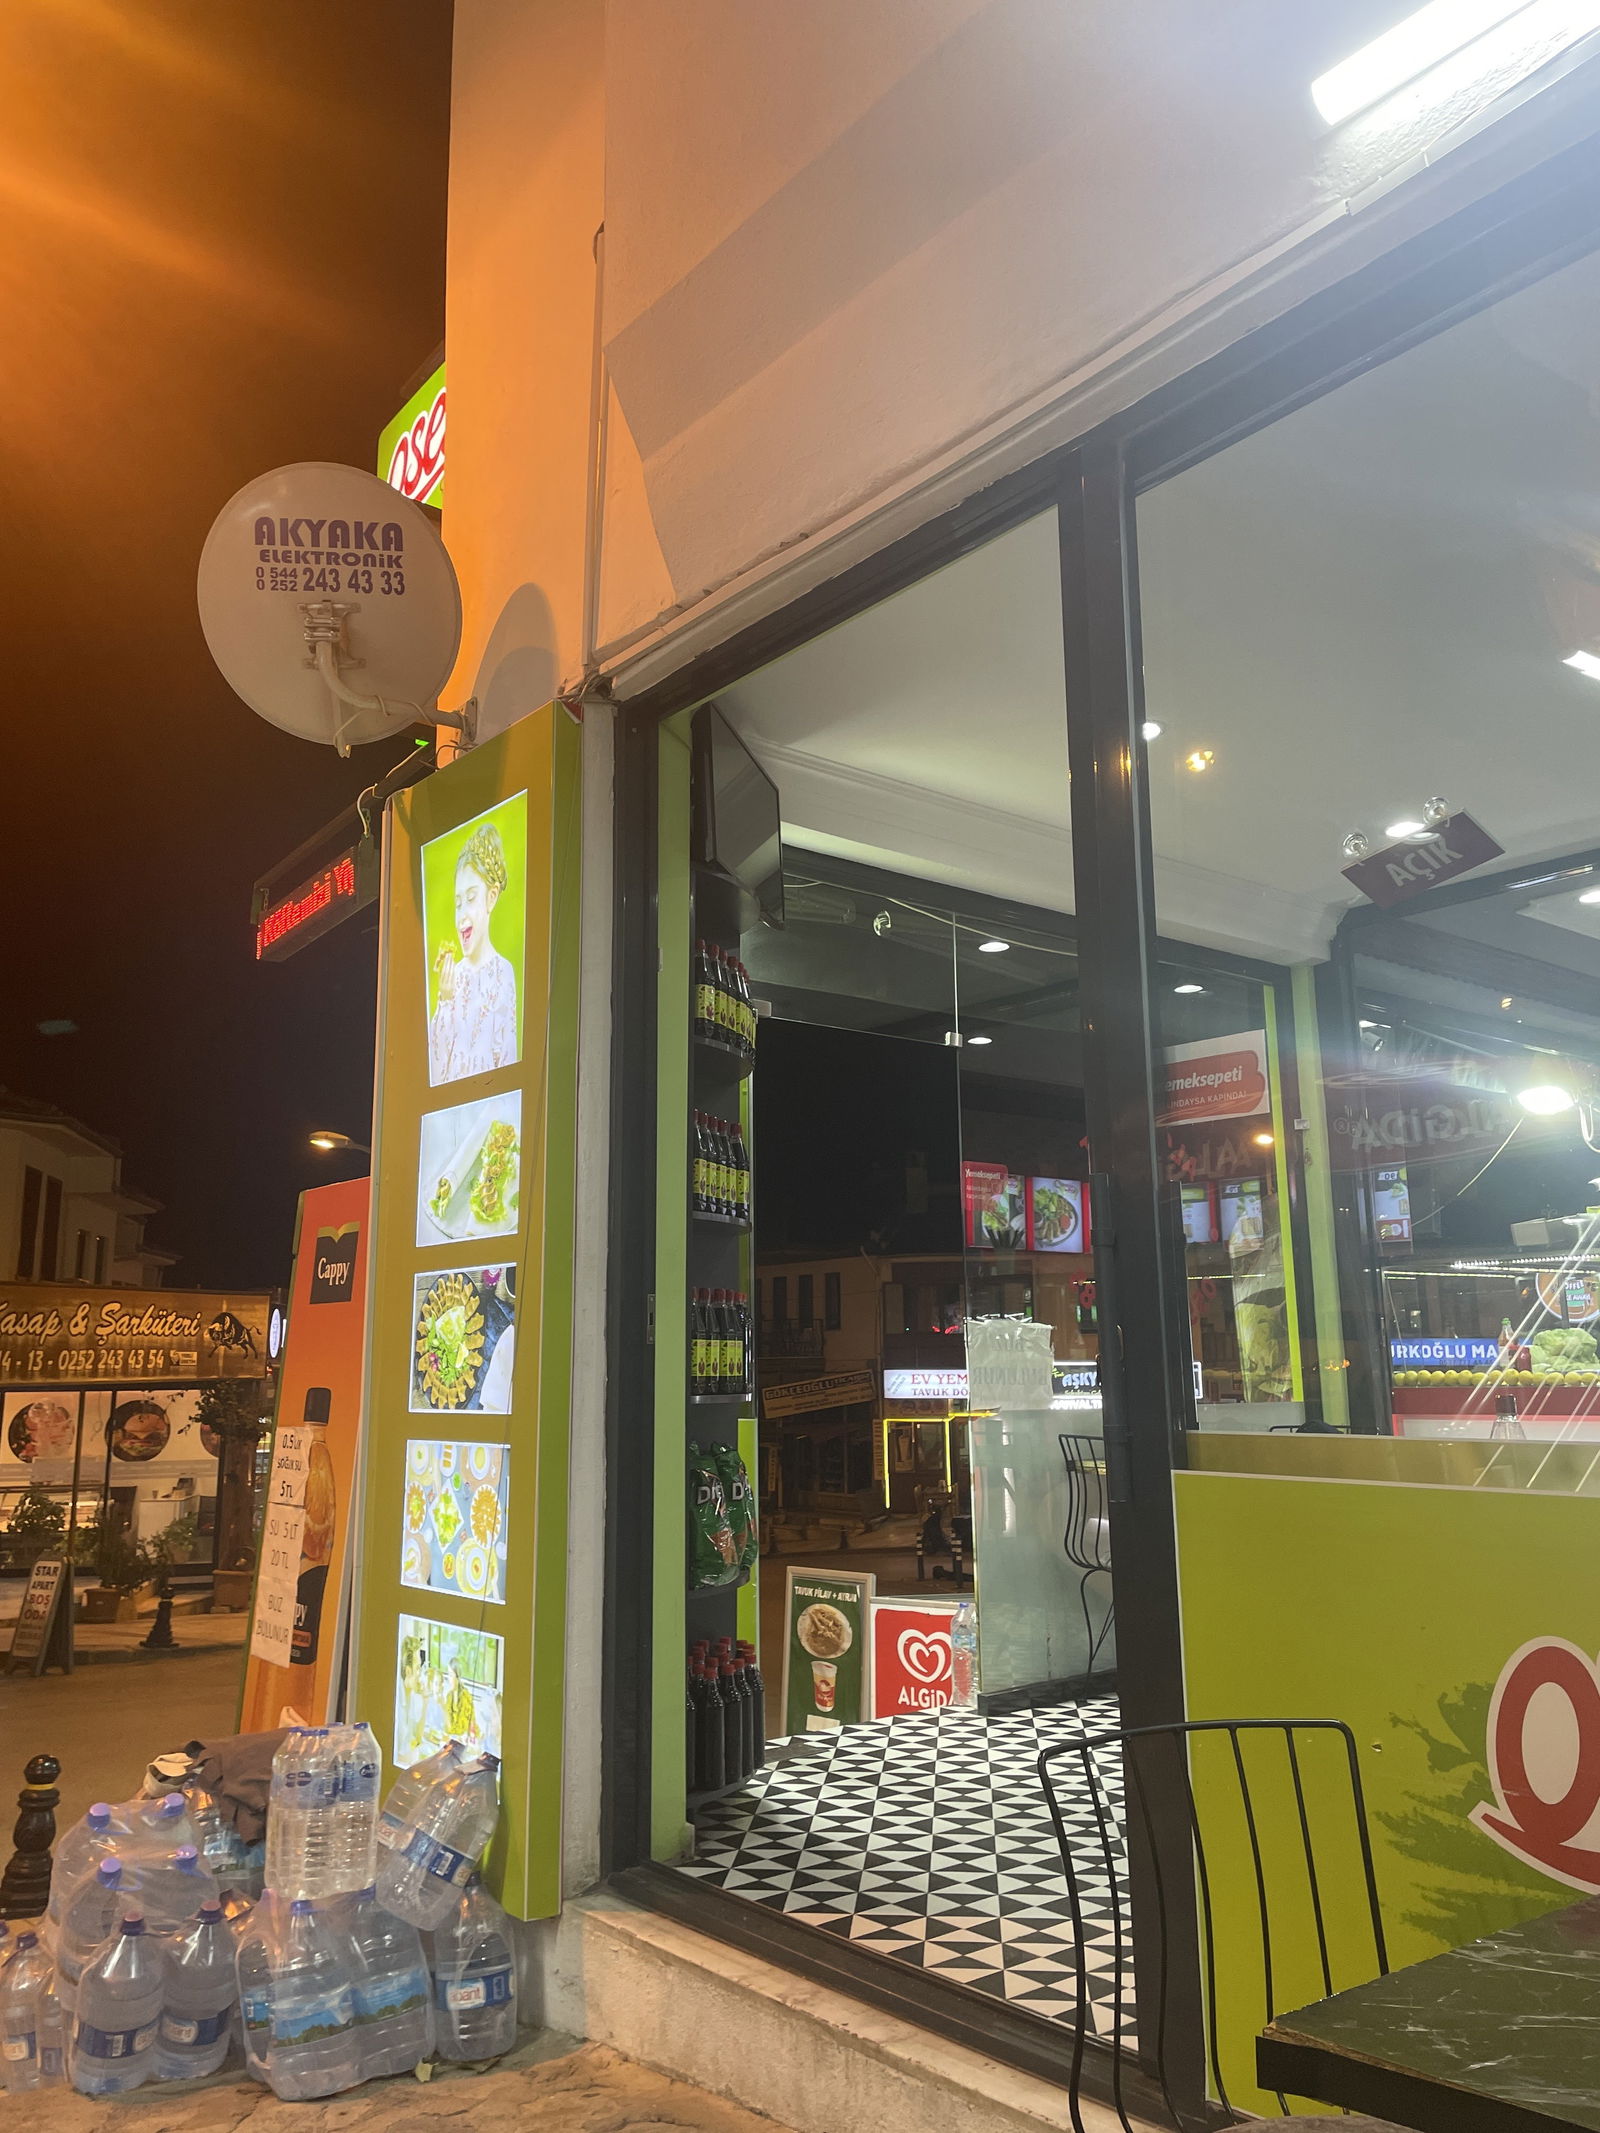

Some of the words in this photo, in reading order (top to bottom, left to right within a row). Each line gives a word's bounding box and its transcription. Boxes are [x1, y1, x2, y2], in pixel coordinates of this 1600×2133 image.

[254, 516, 404, 552] AKYAKA
[255, 567, 264, 578] 0
[270, 567, 298, 579] 544
[256, 579, 265, 591] 0
[270, 580, 298, 592] 252
[302, 567, 341, 593] 243
[347, 569, 374, 594] 43
[380, 571, 405, 596] 33
[1385, 835, 1464, 887] AÇIK
[1166, 1065, 1243, 1092] emeksepeti
[317, 1257, 350, 1286] Cappy
[69, 1302, 90, 1335] &
[95, 1302, 200, 1346] Şarküteri
[0, 1350, 11, 1371] 4
[28, 1350, 44, 1371] 13
[59, 1350, 95, 1370] 0252
[98, 1349, 124, 1369] 243
[128, 1349, 144, 1369] 43
[147, 1349, 164, 1369] 54
[1471, 1344, 1498, 1359] MA
[911, 1373, 931, 1385] EV
[936, 1373, 968, 1385] YEM
[1062, 1371, 1098, 1390] AŞKY
[911, 1387, 950, 1397] TAVUK
[952, 1386, 969, 1397] DÖ
[35, 1565, 59, 1577] STAR
